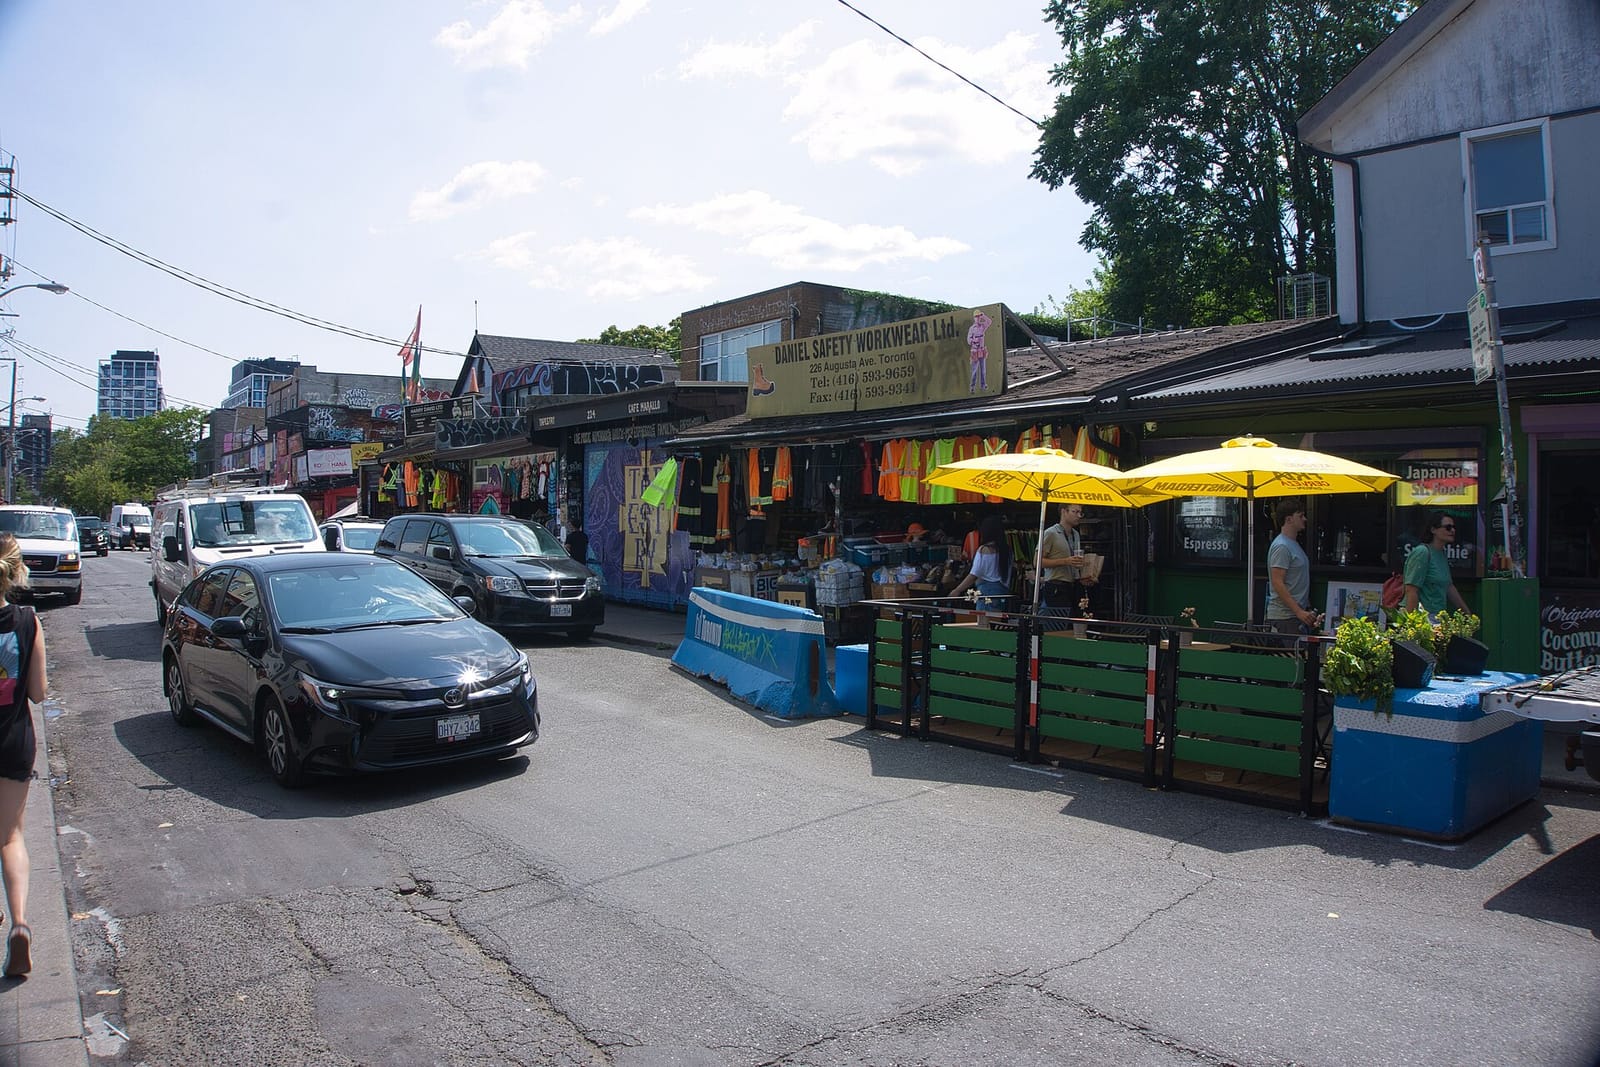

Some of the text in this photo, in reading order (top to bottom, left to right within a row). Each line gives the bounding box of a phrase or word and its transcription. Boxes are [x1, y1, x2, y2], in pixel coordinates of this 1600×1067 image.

[775, 316, 959, 364] DANIEL SAFETY WORKWEAR Ltd.
[809, 351, 915, 374] 226 Augusta Ave. Toronto
[810, 365, 915, 389] Tel: (416) 593-9659
[810, 391, 832, 404] Fax:
[834, 387, 861, 401] (416)
[627, 402, 639, 414] CAFE
[1433, 482, 1466, 496] Food
[1183, 537, 1229, 552] Espresso
[464, 719, 480, 733] 342
